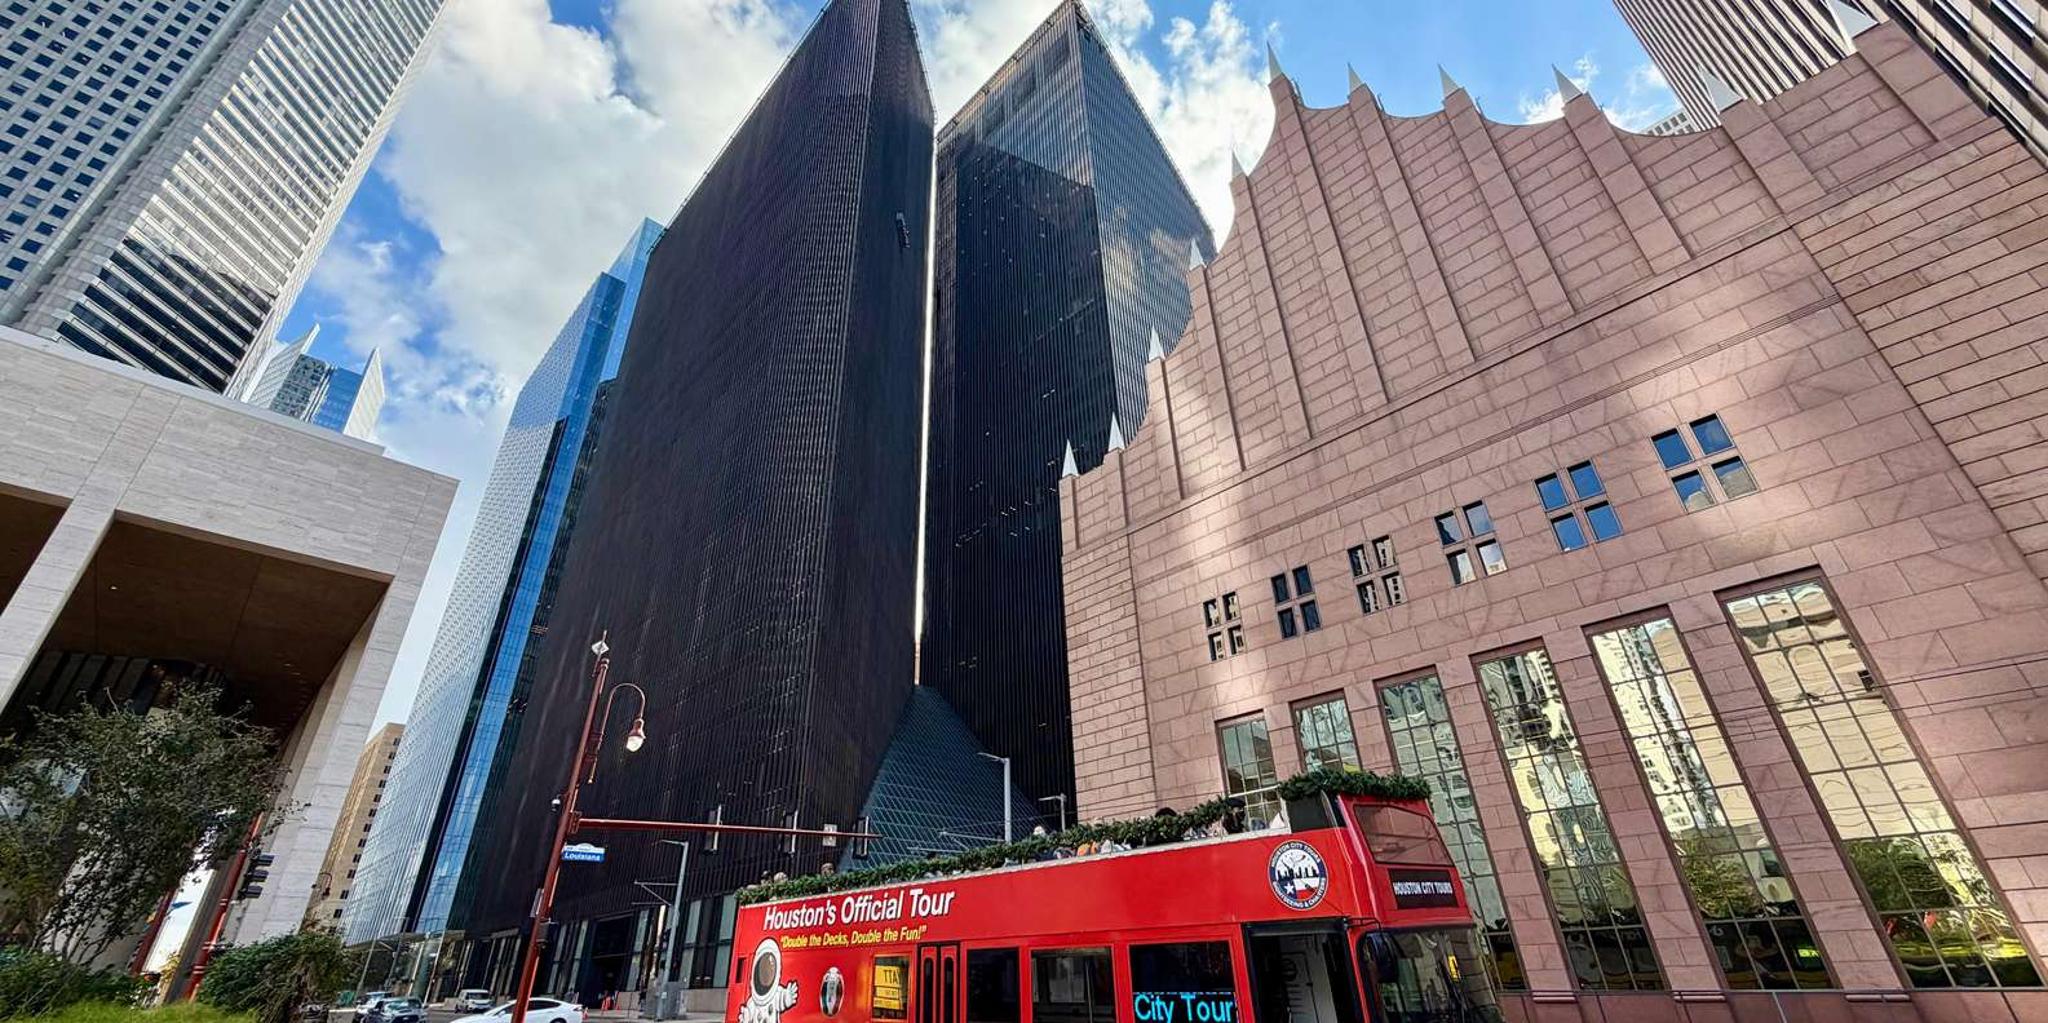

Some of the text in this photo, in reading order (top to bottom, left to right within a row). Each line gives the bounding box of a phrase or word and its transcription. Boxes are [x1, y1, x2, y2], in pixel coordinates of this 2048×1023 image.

[1392, 882, 1453, 895] HOUSTON CITY TOURS
[764, 889, 955, 930] Houston's Official Tour
[809, 933, 822, 947] the
[823, 930, 850, 946] Decks,
[851, 927, 882, 944] Double
[883, 926, 898, 942] the
[1135, 992, 1233, 1023] City Tour
